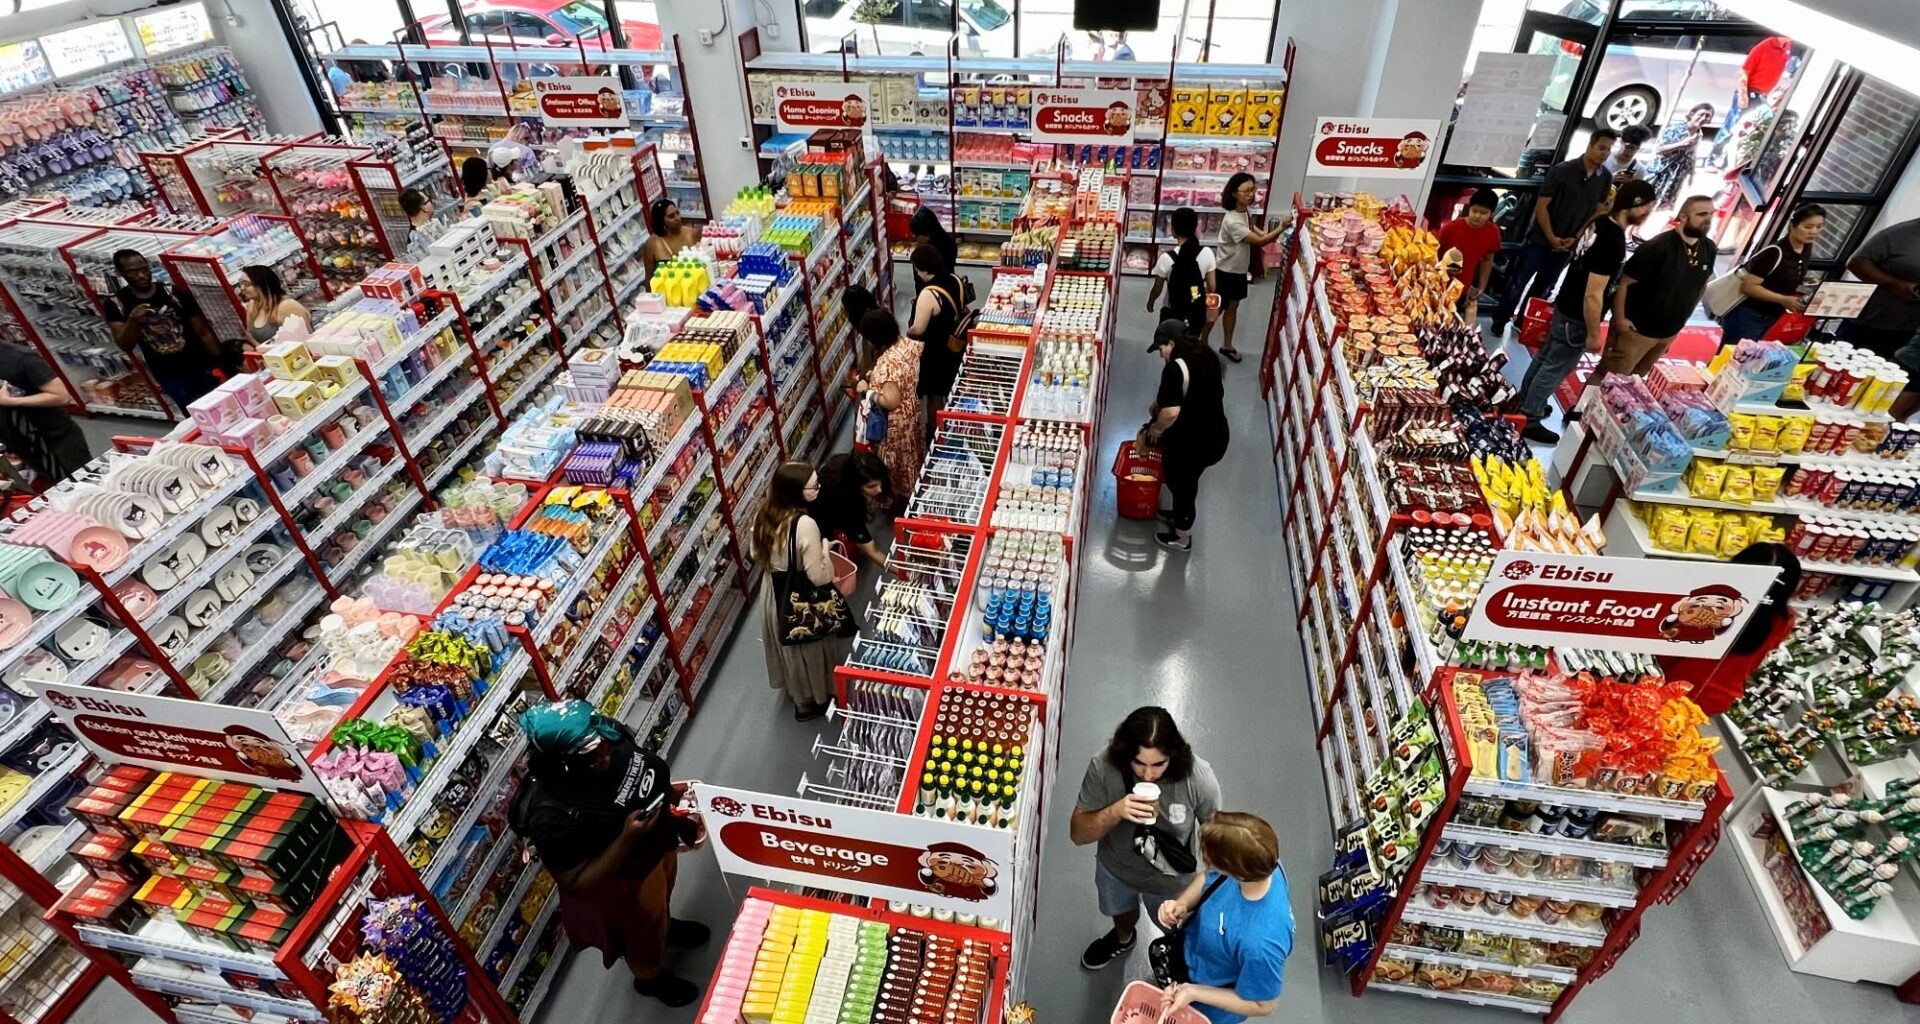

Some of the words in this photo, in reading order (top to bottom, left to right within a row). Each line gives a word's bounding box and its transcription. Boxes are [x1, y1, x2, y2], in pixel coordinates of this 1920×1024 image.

[548, 82, 571, 91] Ebisu
[790, 88, 815, 97] Ebisu
[545, 98, 574, 107] Stationery
[577, 98, 596, 106] Office
[1051, 95, 1078, 104] Ebisu
[783, 105, 806, 114] Home
[807, 105, 840, 117] Cleaning
[1053, 110, 1094, 123] Snacks
[1337, 124, 1370, 134] Ebisu
[1336, 141, 1384, 156] Snacks
[1540, 564, 1614, 584] Ebisu
[1502, 592, 1591, 614] Instant
[1596, 599, 1663, 619] Food
[1506, 610, 1552, 621] 方便速食
[1556, 614, 1636, 628] インスタント食品
[79, 696, 147, 718] Ebisu
[80, 719, 133, 735] Kitchen
[133, 729, 159, 740] and
[158, 730, 227, 749] Bathroom
[133, 735, 190, 752] Supplies
[614, 777, 635, 807] TOWARDS
[629, 765, 640, 777] THE
[751, 803, 833, 829] Ebisu
[760, 831, 889, 867] Beverage
[823, 860, 862, 873] ドリンク
